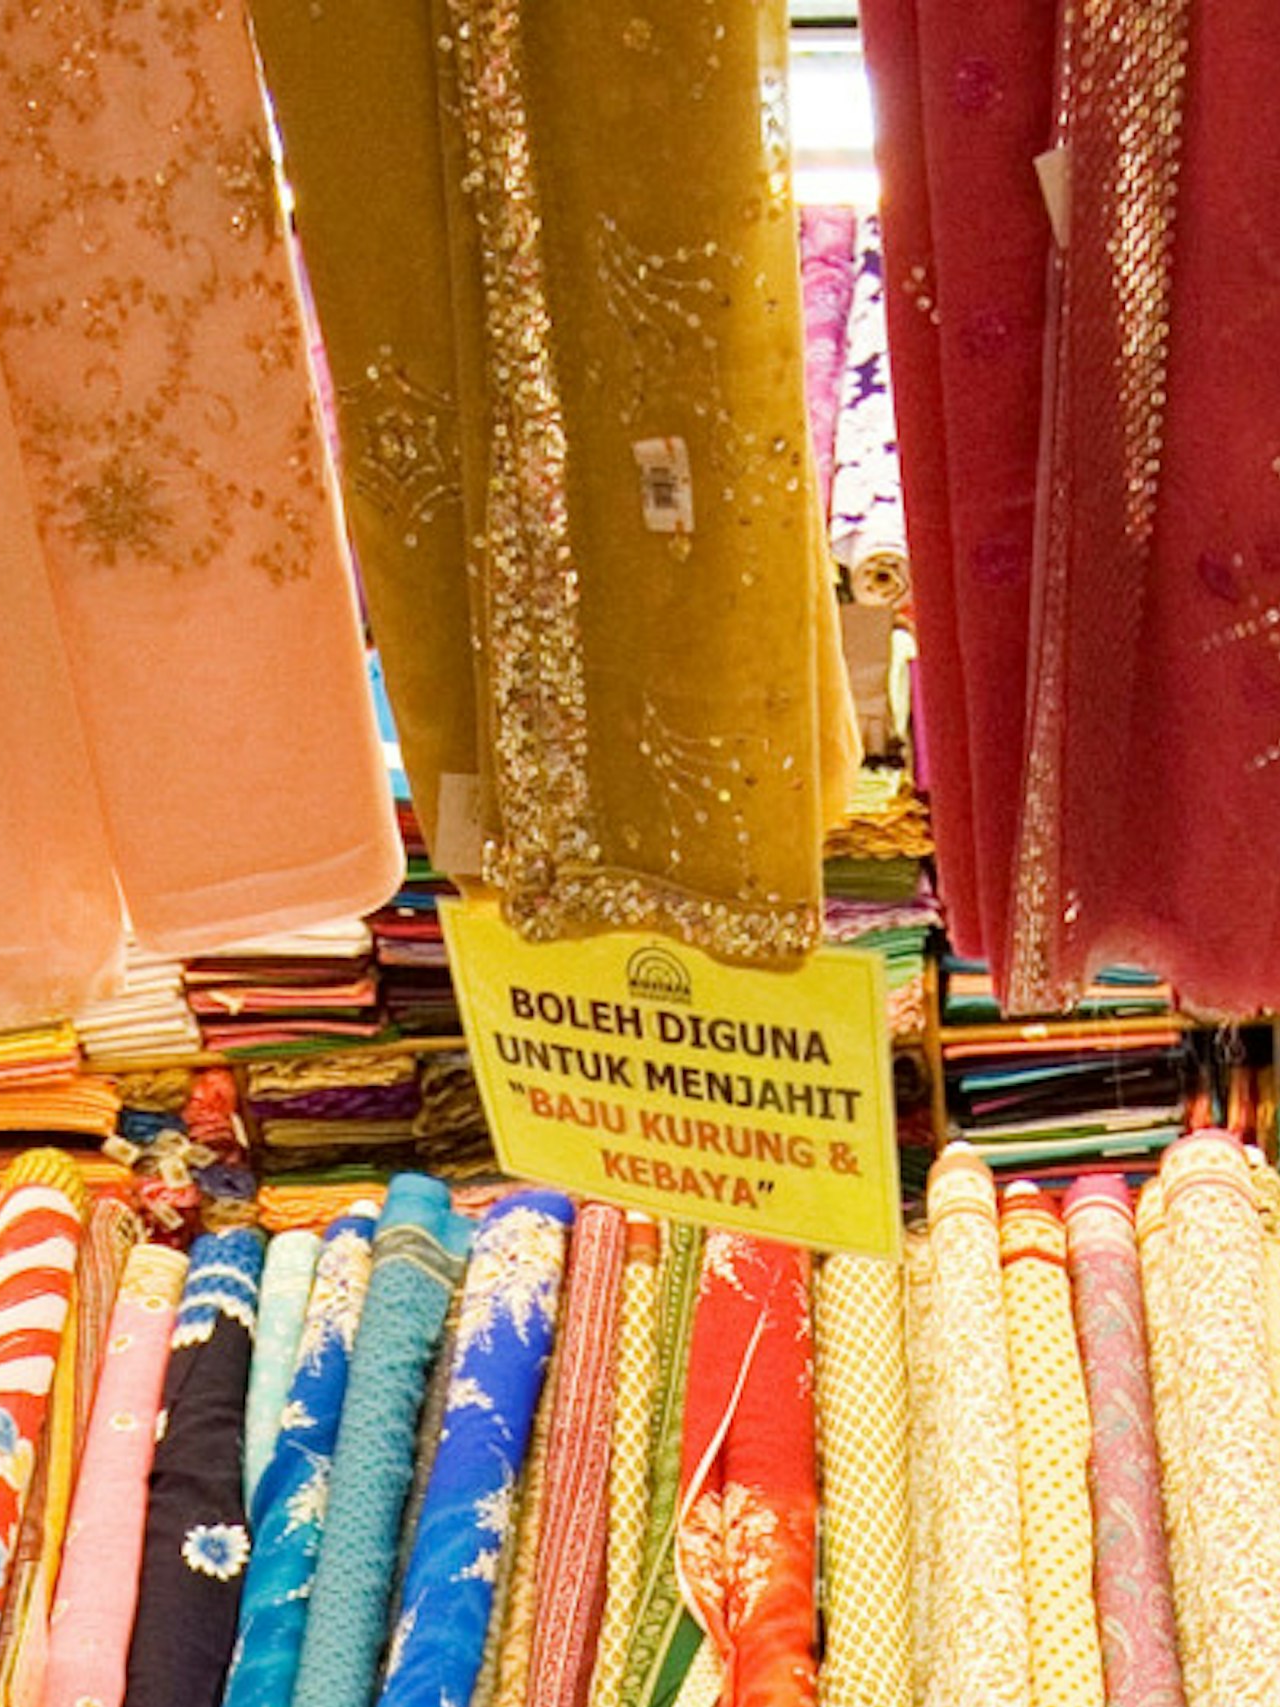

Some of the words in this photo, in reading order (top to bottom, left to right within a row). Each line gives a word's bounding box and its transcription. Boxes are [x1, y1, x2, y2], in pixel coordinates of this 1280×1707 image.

[509, 985, 644, 1039] BOLEH
[656, 1010, 832, 1066] DIGUNA
[494, 1033, 632, 1088] UNTUK
[644, 1060, 862, 1122] MENJAHIT
[508, 1082, 627, 1134] "BAJU
[639, 1110, 816, 1169] KURUNG
[826, 1142, 862, 1177] &
[601, 1149, 775, 1210] KEBAYA"
